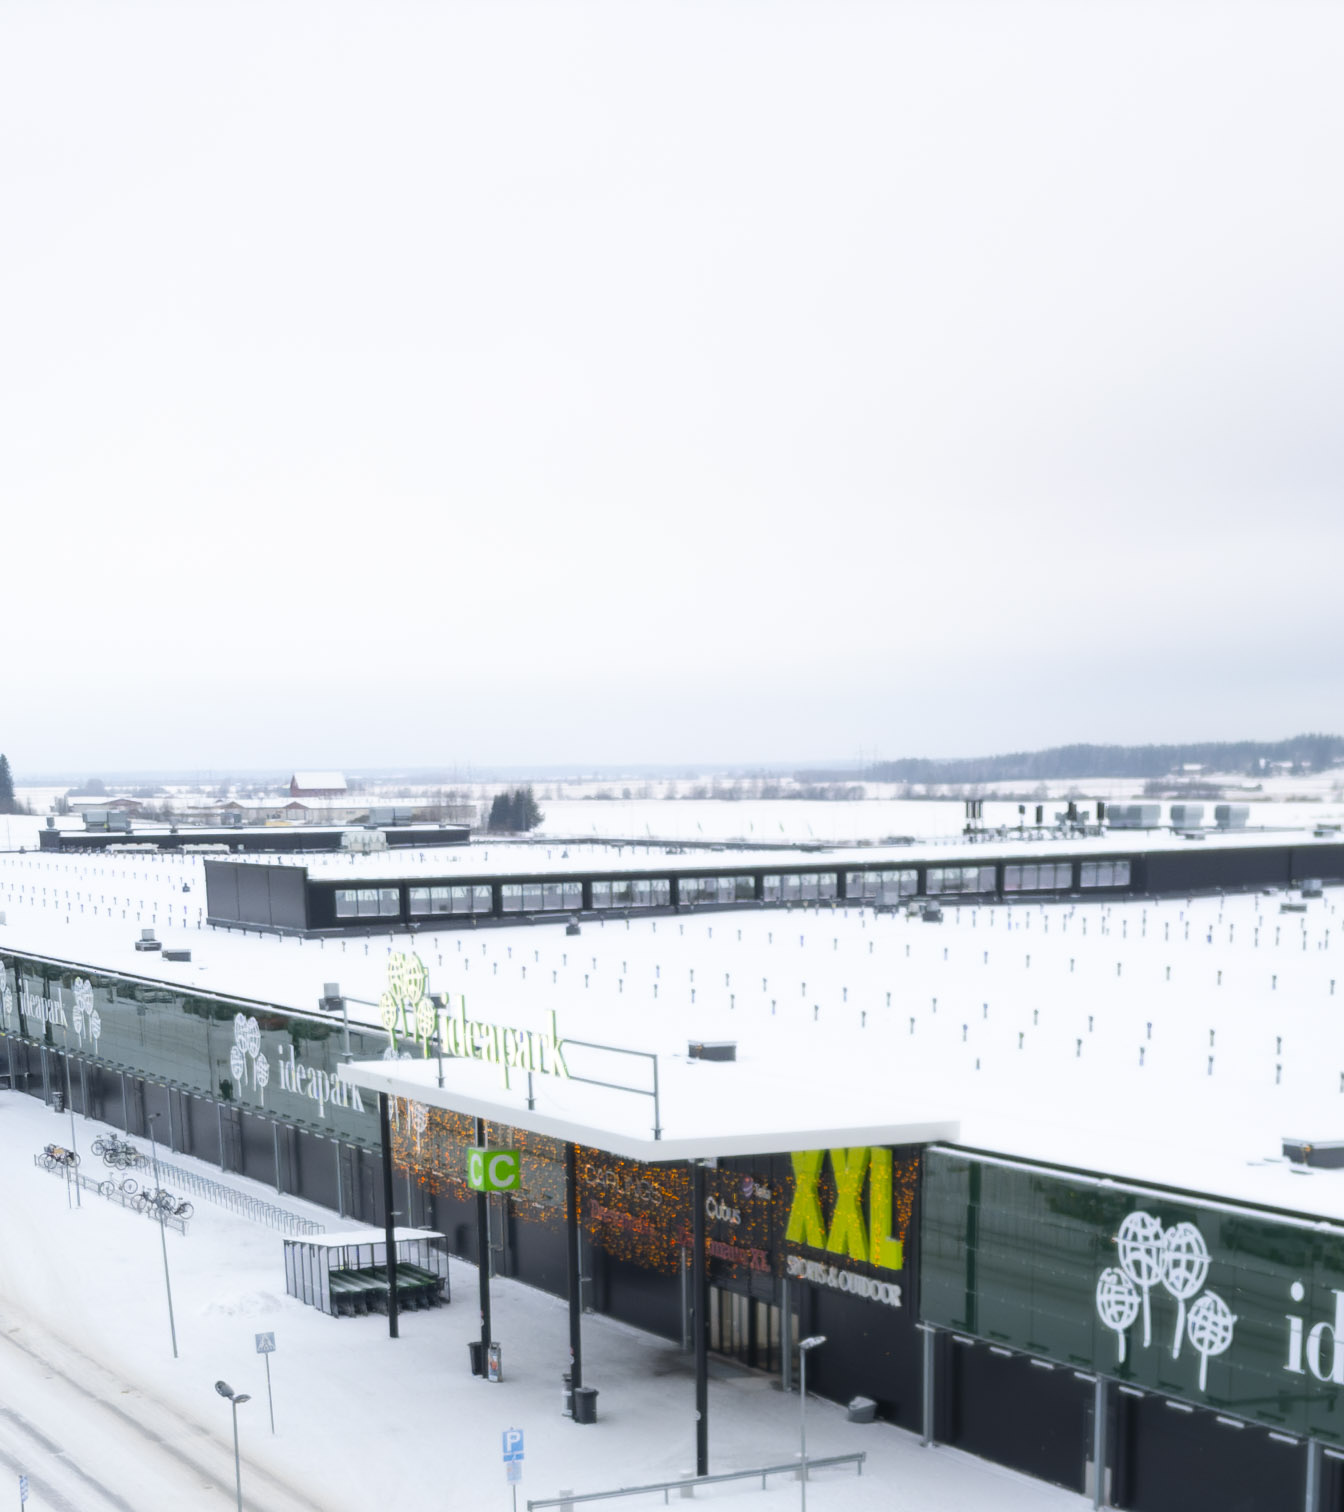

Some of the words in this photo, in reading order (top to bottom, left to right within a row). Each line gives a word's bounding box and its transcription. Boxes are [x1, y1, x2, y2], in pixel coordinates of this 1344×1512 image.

[18, 978, 68, 1034] ideapark
[439, 991, 570, 1090] ideapark
[470, 1153, 482, 1187] C
[488, 1154, 516, 1188] C
[785, 1147, 904, 1271] XXL
[839, 1270, 902, 1308] OUTDOOR
[507, 1432, 521, 1451] P
